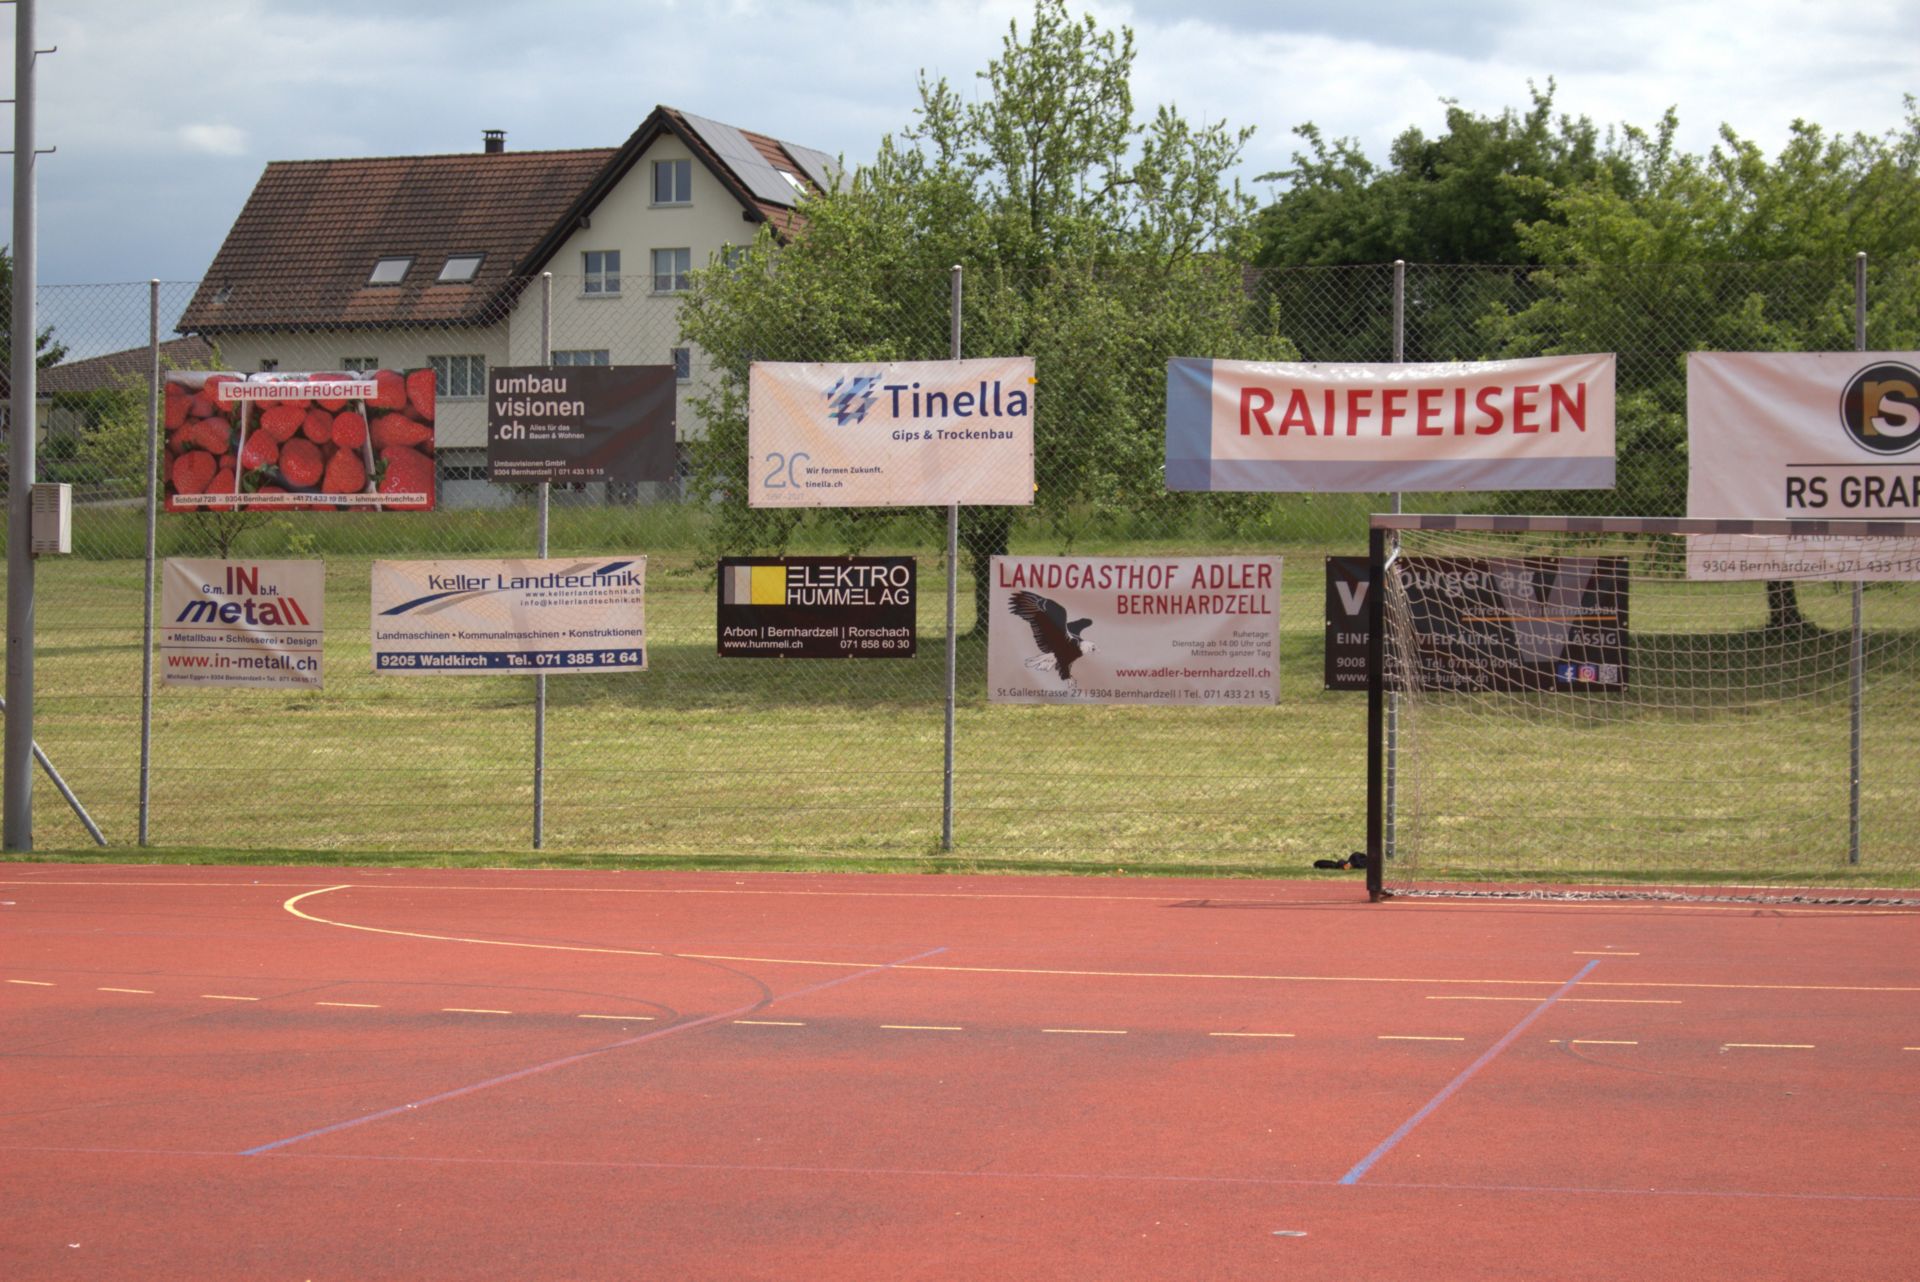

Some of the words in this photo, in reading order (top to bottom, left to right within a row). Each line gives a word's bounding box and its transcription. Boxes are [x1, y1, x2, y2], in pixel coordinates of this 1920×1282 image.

[303, 382, 372, 397] FRÜCHTE
[495, 374, 567, 394] umbau
[495, 397, 585, 417] visionen
[883, 381, 1028, 418] Tinella
[1239, 382, 1586, 436] RAIFFEISEN
[494, 420, 525, 440] .ch
[892, 430, 920, 442] Gips
[923, 430, 933, 440] &
[937, 429, 1014, 440] Trockenbau
[511, 468, 553, 476] Bernhardzell
[821, 466, 849, 474] formen
[850, 466, 884, 474] Zukunft.
[805, 480, 843, 488] tinella.ch
[1786, 476, 1829, 508] RS
[1702, 560, 1736, 573] 9304
[1739, 559, 1827, 573] Bernhardzell
[202, 584, 225, 595] G.m.
[226, 566, 259, 596] IN
[260, 585, 279, 596] b.H.
[428, 574, 491, 590] Keller
[497, 570, 641, 590] Landtechnik
[788, 565, 910, 587] ELEKTRO
[999, 562, 1179, 590] LANDGASTHOF
[1191, 563, 1273, 589] ADLER
[525, 589, 641, 598] www.kellerlandtechnik.ch
[787, 588, 876, 606] HUMMEL
[879, 588, 910, 605] AG
[520, 597, 641, 607] info@kellerlandtechnik.ch
[1117, 594, 1271, 615] BERNHARDZELL
[175, 597, 310, 626] metall
[376, 631, 450, 640] Landmaschinen
[458, 630, 560, 640] Kommunalmaschinen
[569, 628, 642, 638] Konstruktionen
[723, 626, 758, 637] Arbon
[767, 626, 839, 637] Bernhardzell
[848, 626, 910, 637] Rorschach
[174, 633, 217, 643] Metallbau
[226, 634, 278, 645] Schlosserei
[286, 638, 318, 648] Design
[840, 640, 858, 649] 071
[861, 640, 879, 649] 858
[882, 640, 895, 649] 60
[897, 640, 910, 649] 30
[1172, 640, 1205, 648] Dienstag
[381, 655, 416, 667] 9205
[420, 654, 488, 667] Waldkirch
[506, 654, 532, 666] Tel.
[536, 653, 561, 665] 071
[567, 653, 594, 664] 385
[599, 652, 616, 664] 12
[619, 652, 638, 663] 64
[1191, 649, 1227, 657] Mittwoch
[1229, 650, 1255, 658] ganzer
[1257, 649, 1271, 658] Tag
[168, 653, 318, 671] www.in-metall.ch
[1337, 657, 1366, 668] 9008
[1116, 667, 1271, 678] www.adler-bernhardzell.ch
[1070, 688, 1082, 698] 27
[1090, 689, 1112, 699] 9304
[1115, 688, 1176, 699] Bernhardzell
[1184, 689, 1201, 699] Tel.
[1204, 689, 1220, 699] 071
[1223, 689, 1241, 699] 433
[1244, 689, 1255, 699] 21
[1259, 689, 1271, 699] 15
